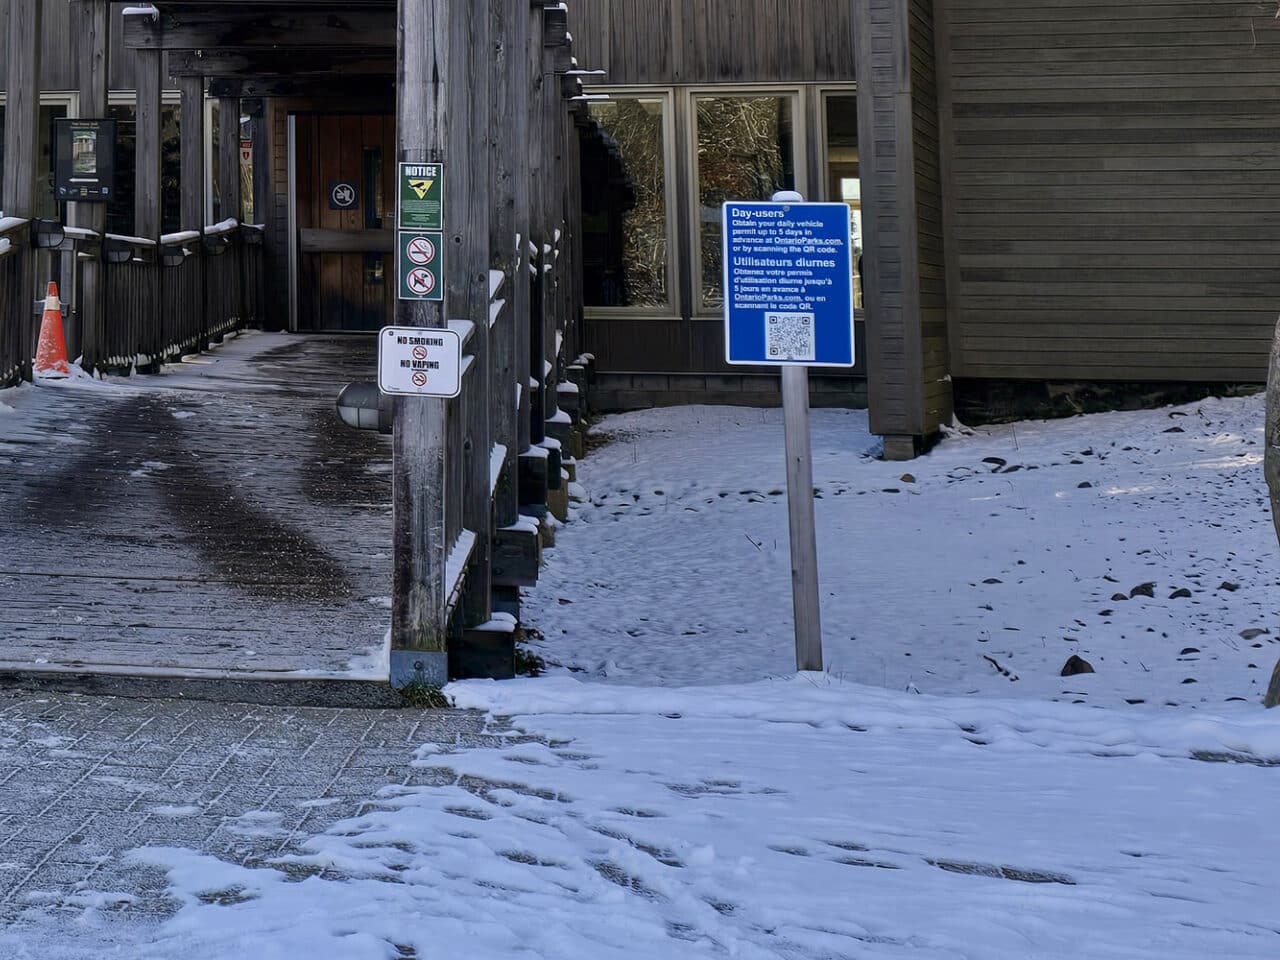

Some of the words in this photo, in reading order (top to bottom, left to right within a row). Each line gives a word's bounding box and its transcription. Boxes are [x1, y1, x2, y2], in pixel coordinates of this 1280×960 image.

[405, 166, 437, 176] NOTICE
[732, 208, 785, 219] Day-users
[777, 220, 795, 228] daily
[743, 245, 752, 253] by
[733, 257, 793, 267] Utilisateurs
[795, 258, 836, 267] diurnes
[740, 285, 760, 293] jours
[397, 336, 407, 344] NO
[409, 337, 443, 346] SMOKING
[400, 360, 410, 368] NO
[412, 360, 439, 369] VAPING
